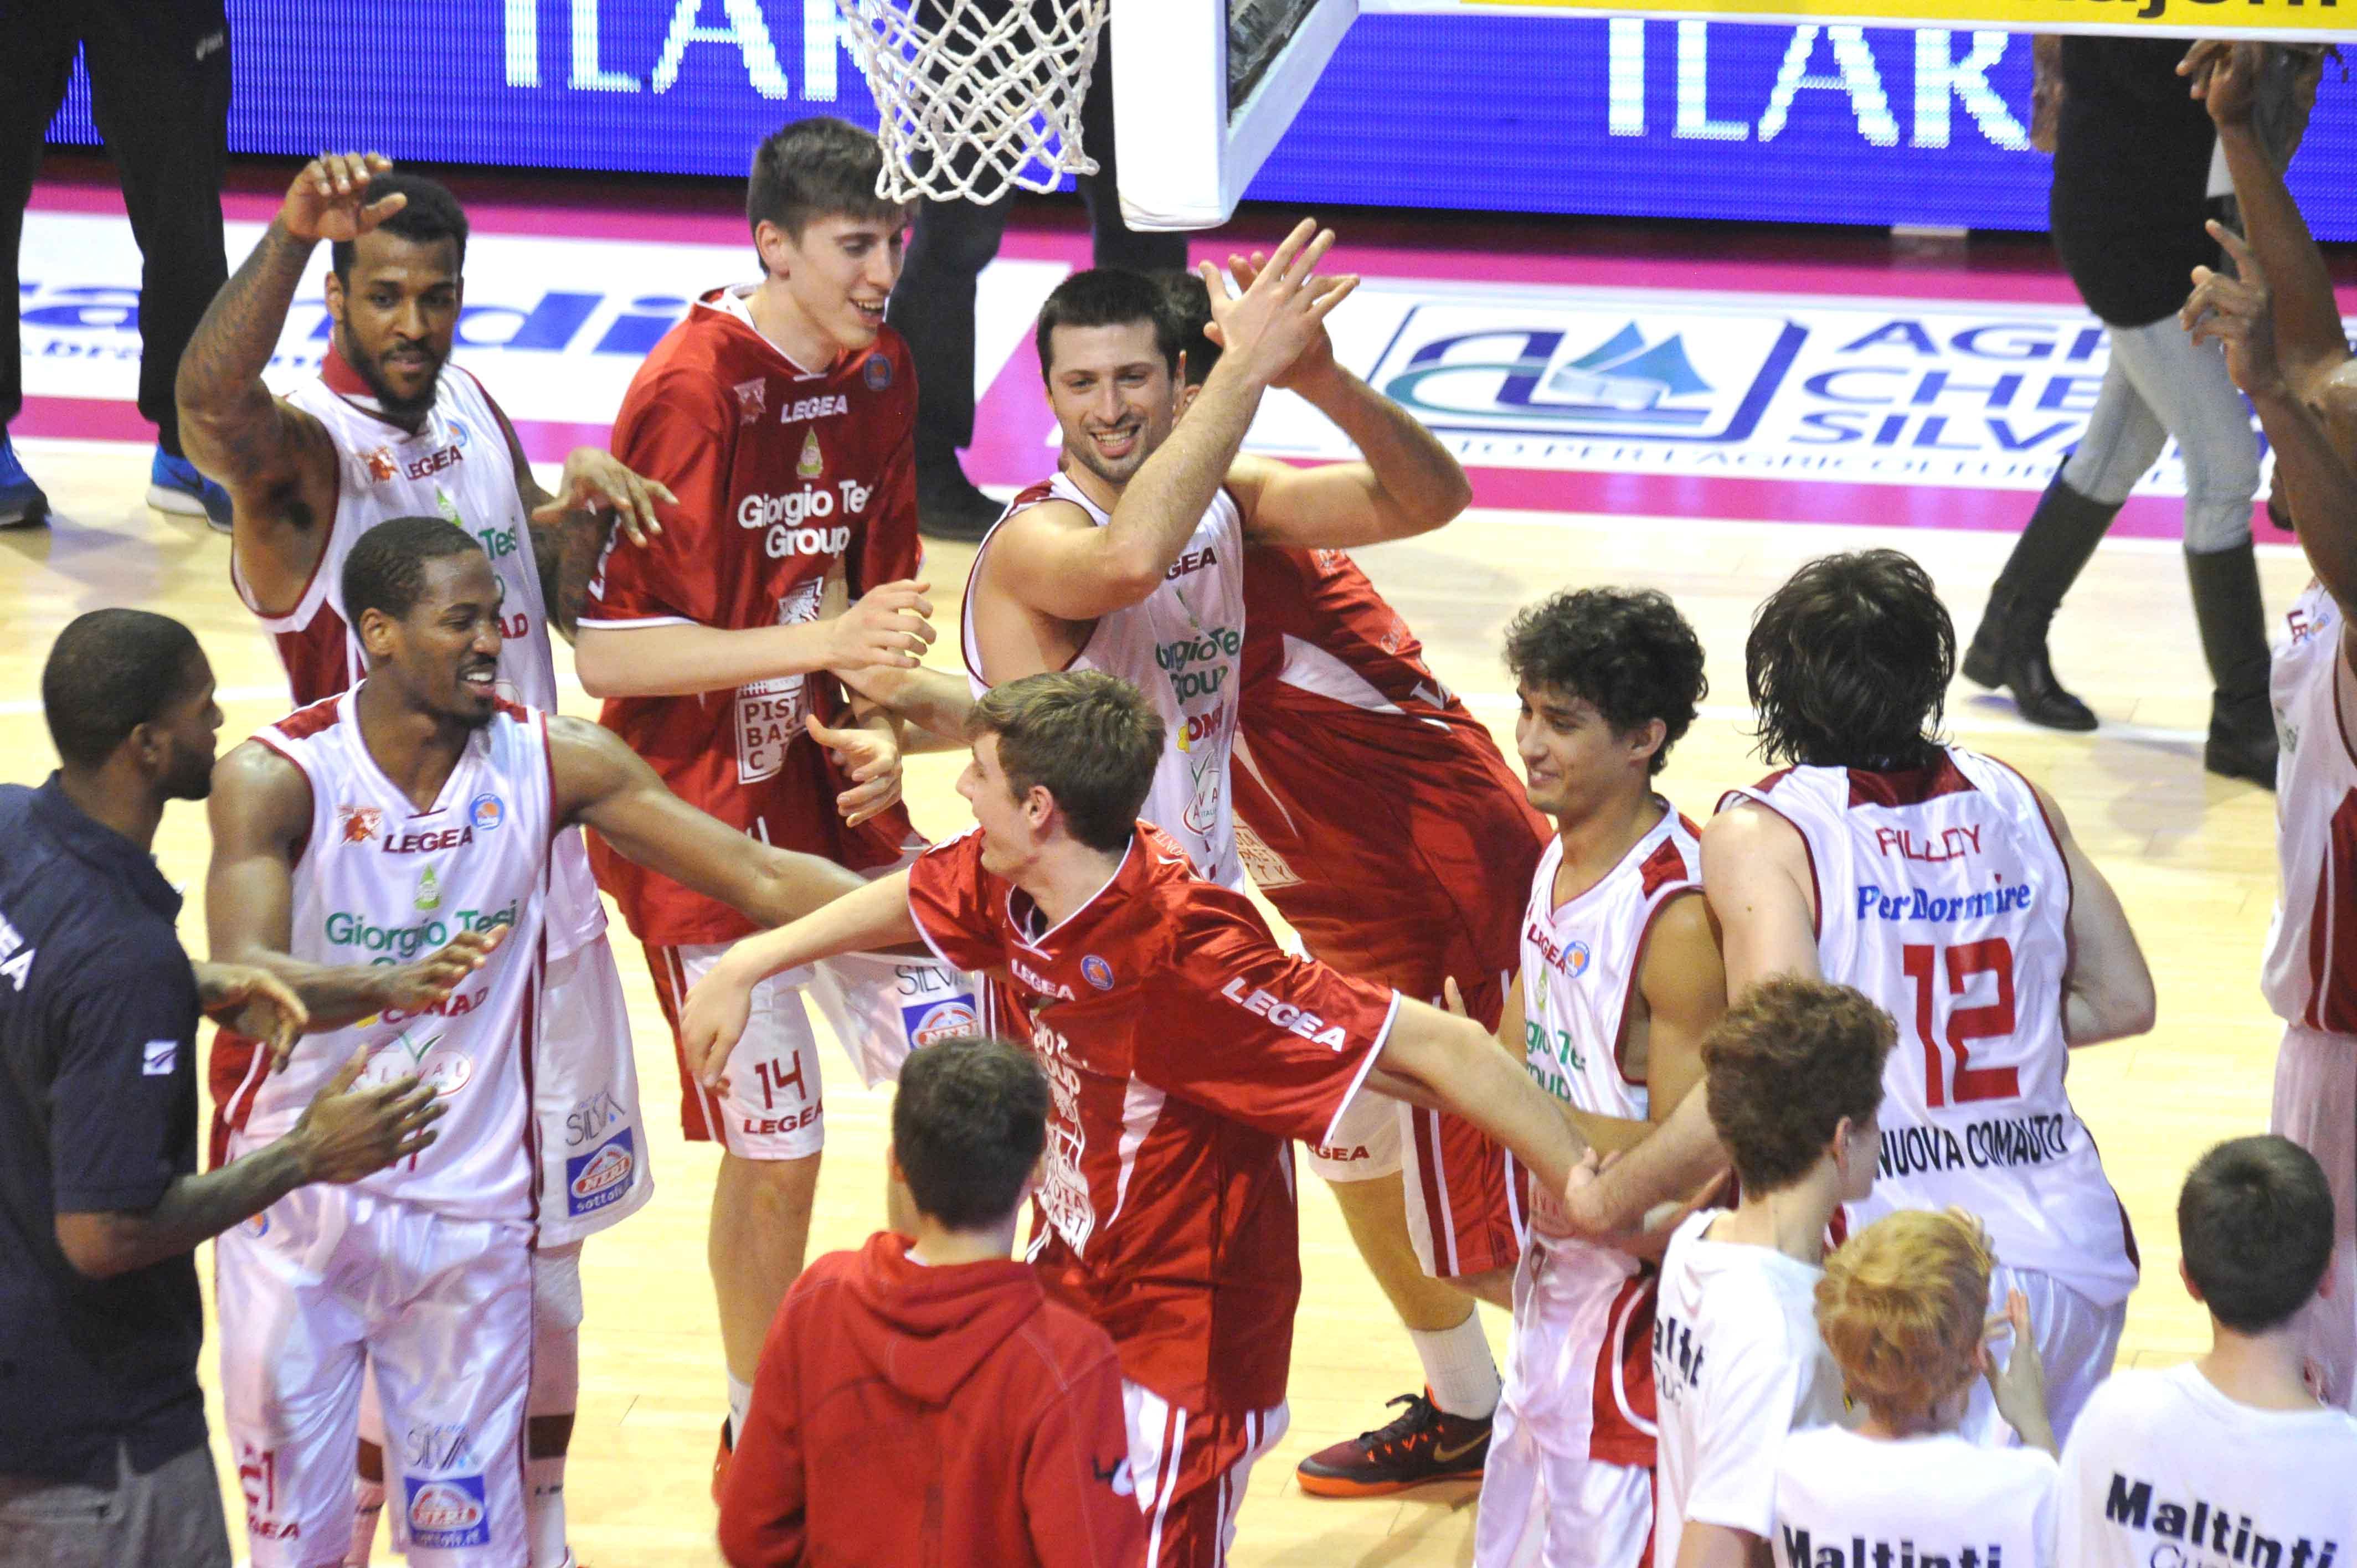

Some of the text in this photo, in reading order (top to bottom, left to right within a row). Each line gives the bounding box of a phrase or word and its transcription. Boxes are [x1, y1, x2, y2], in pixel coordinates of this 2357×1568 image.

[780, 395, 848, 424] LEGEA
[737, 483, 833, 529] Giorgio
[765, 525, 851, 558] Group
[1165, 546, 1217, 581] GEA
[382, 826, 474, 854] LEGEA
[1857, 873, 2031, 922] PerDormire
[325, 911, 447, 958] Giorgio
[1011, 959, 1076, 1001] LEGEA
[1221, 977, 1348, 1053] LEGEA
[1903, 936, 2021, 1108] 12
[754, 1050, 806, 1110] 14
[1315, 1145, 1370, 1162] GEA
[1874, 1112, 2068, 1181] NUOVA COMAUTO
[2106, 1471, 2338, 1568] Maltinti
